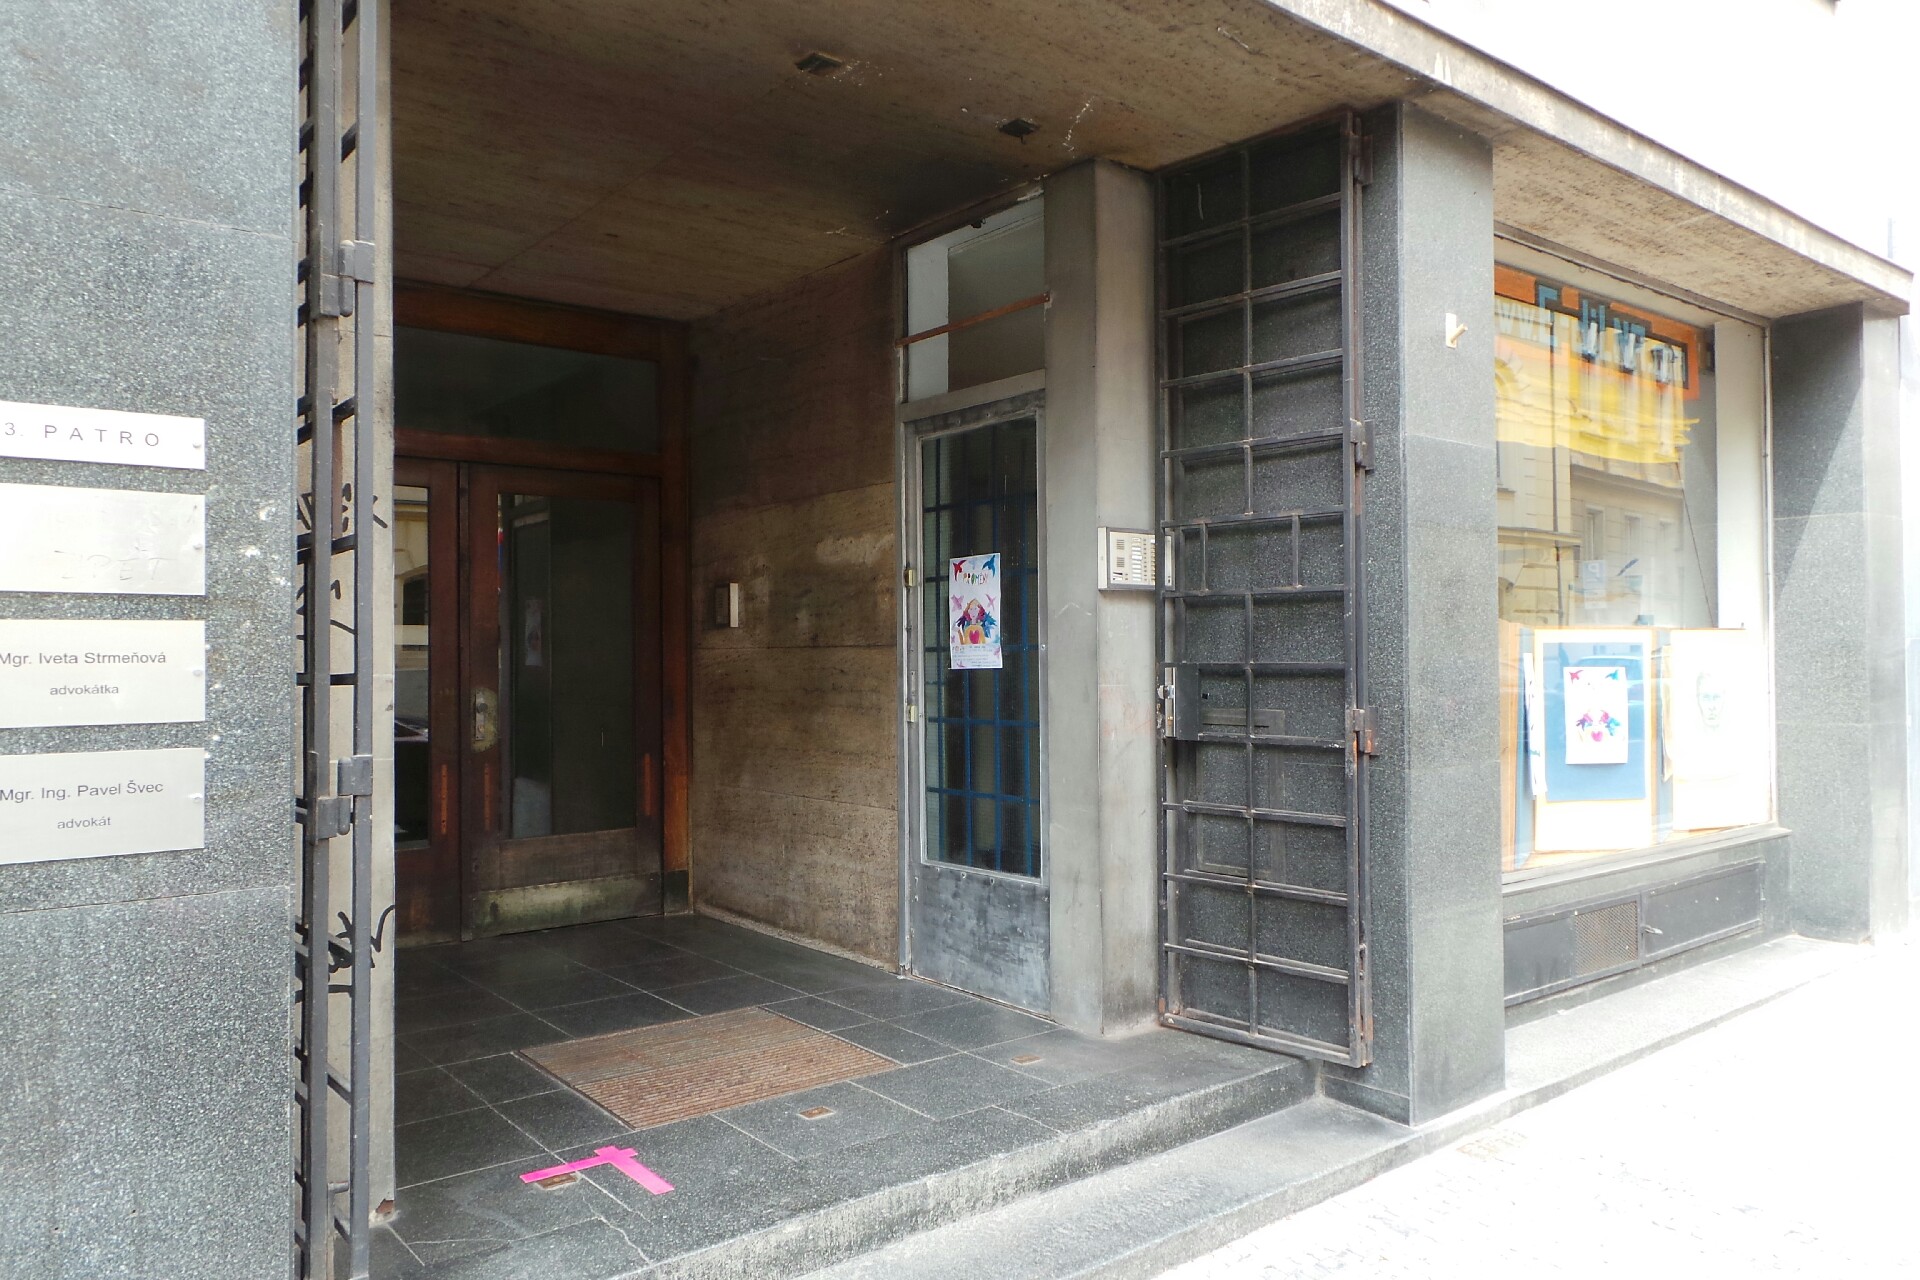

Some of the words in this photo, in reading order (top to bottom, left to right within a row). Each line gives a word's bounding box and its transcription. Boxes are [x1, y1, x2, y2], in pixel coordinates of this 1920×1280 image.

[4, 422, 24, 437] 3.
[43, 424, 160, 447] PATRO
[0, 652, 32, 668] Mgr.
[39, 652, 79, 665] Iveta
[84, 651, 167, 665] Strmeňová
[49, 684, 120, 696] advokátka
[0, 788, 35, 804] Mgr.
[41, 787, 72, 801] Ing.
[77, 783, 122, 798] Pavel
[126, 779, 164, 795] Švec
[56, 815, 112, 830] advokát
